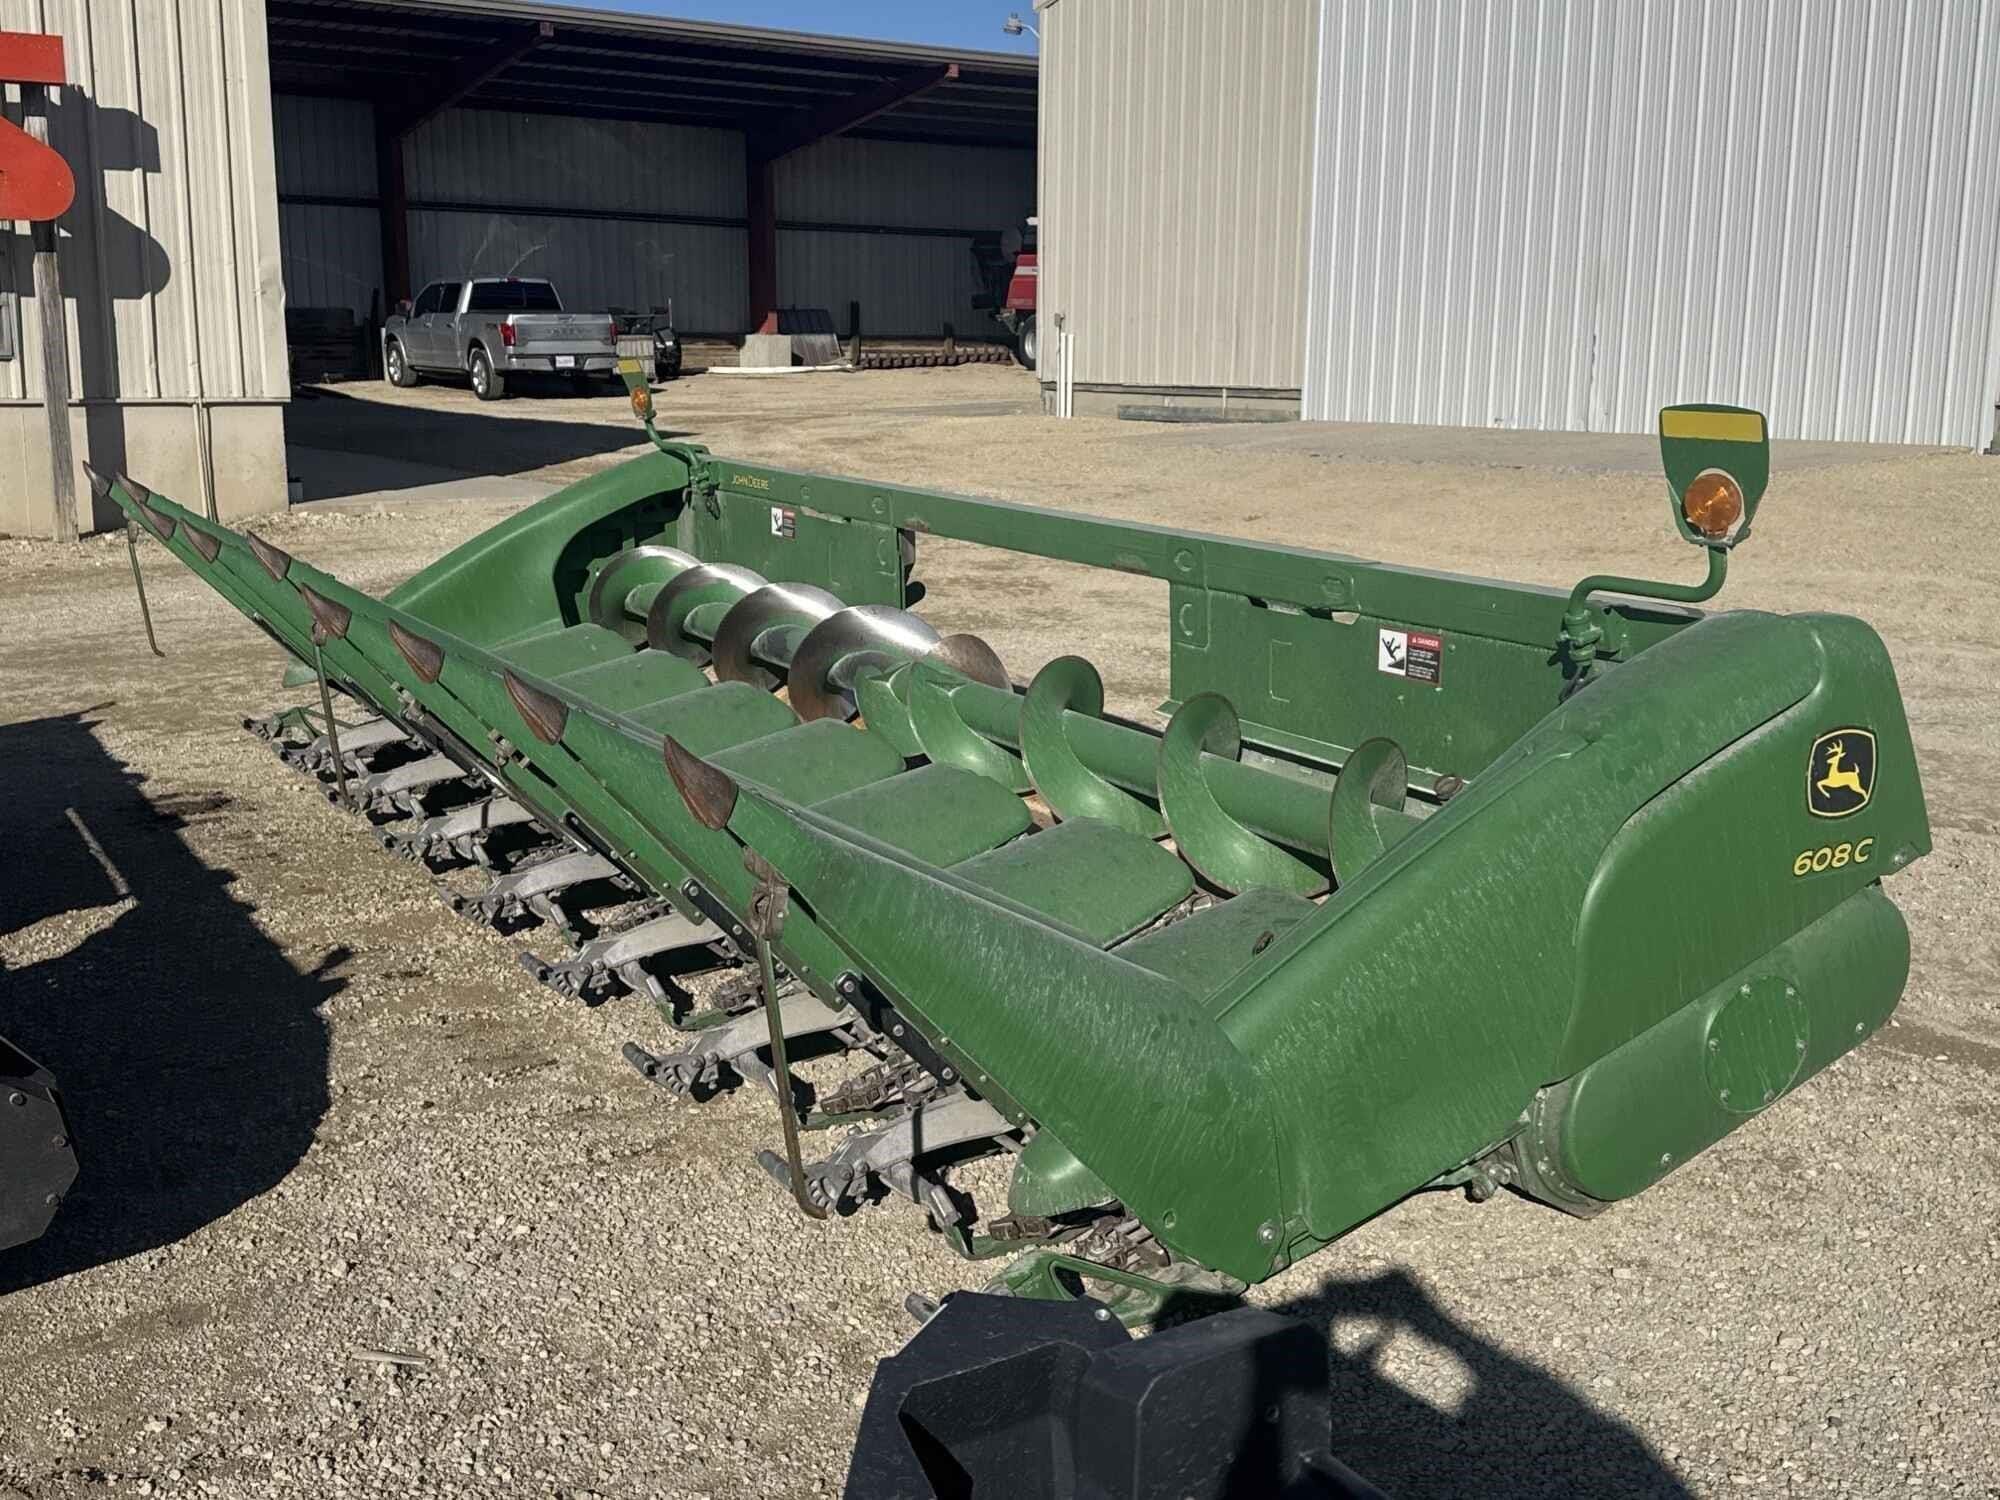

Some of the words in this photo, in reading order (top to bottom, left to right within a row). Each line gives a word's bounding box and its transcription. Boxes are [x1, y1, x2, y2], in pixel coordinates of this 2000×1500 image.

[732, 473, 748, 487] JOHN
[748, 475, 770, 490] DEERE
[1417, 637, 1439, 648] DANGER
[1792, 837, 1873, 876] 608C
